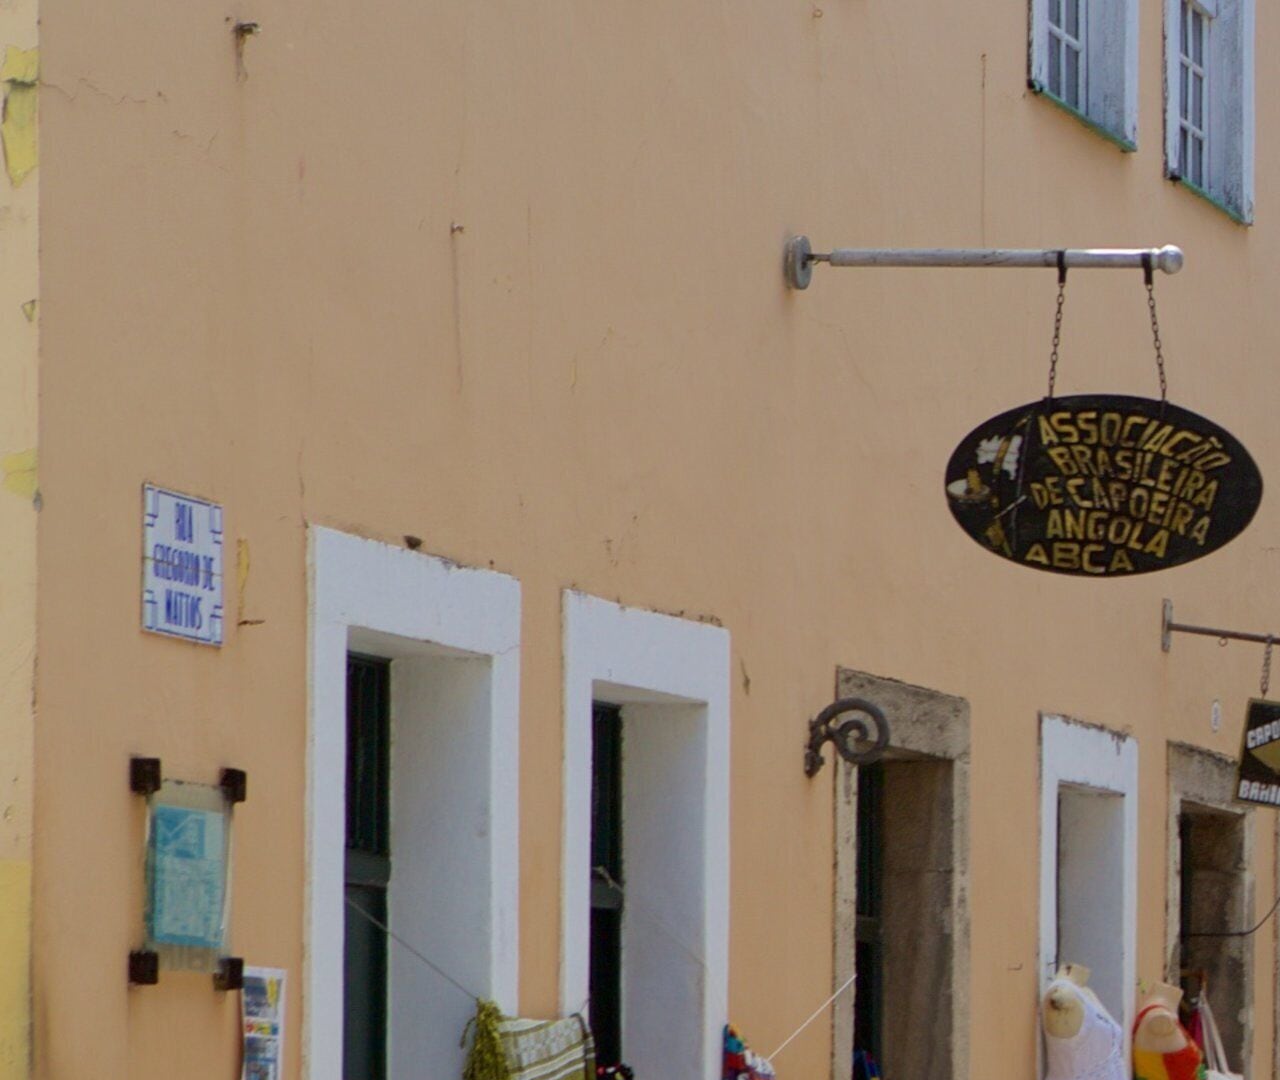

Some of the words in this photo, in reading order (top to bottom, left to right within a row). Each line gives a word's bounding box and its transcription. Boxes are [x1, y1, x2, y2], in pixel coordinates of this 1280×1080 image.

[1050, 446, 1218, 511] BRASILEIRA
[1030, 476, 1064, 509] DE
[1067, 478, 1210, 545] CAPOEIRA
[1046, 509, 1170, 558] ANGOLA
[1025, 543, 1135, 573] ABCA
